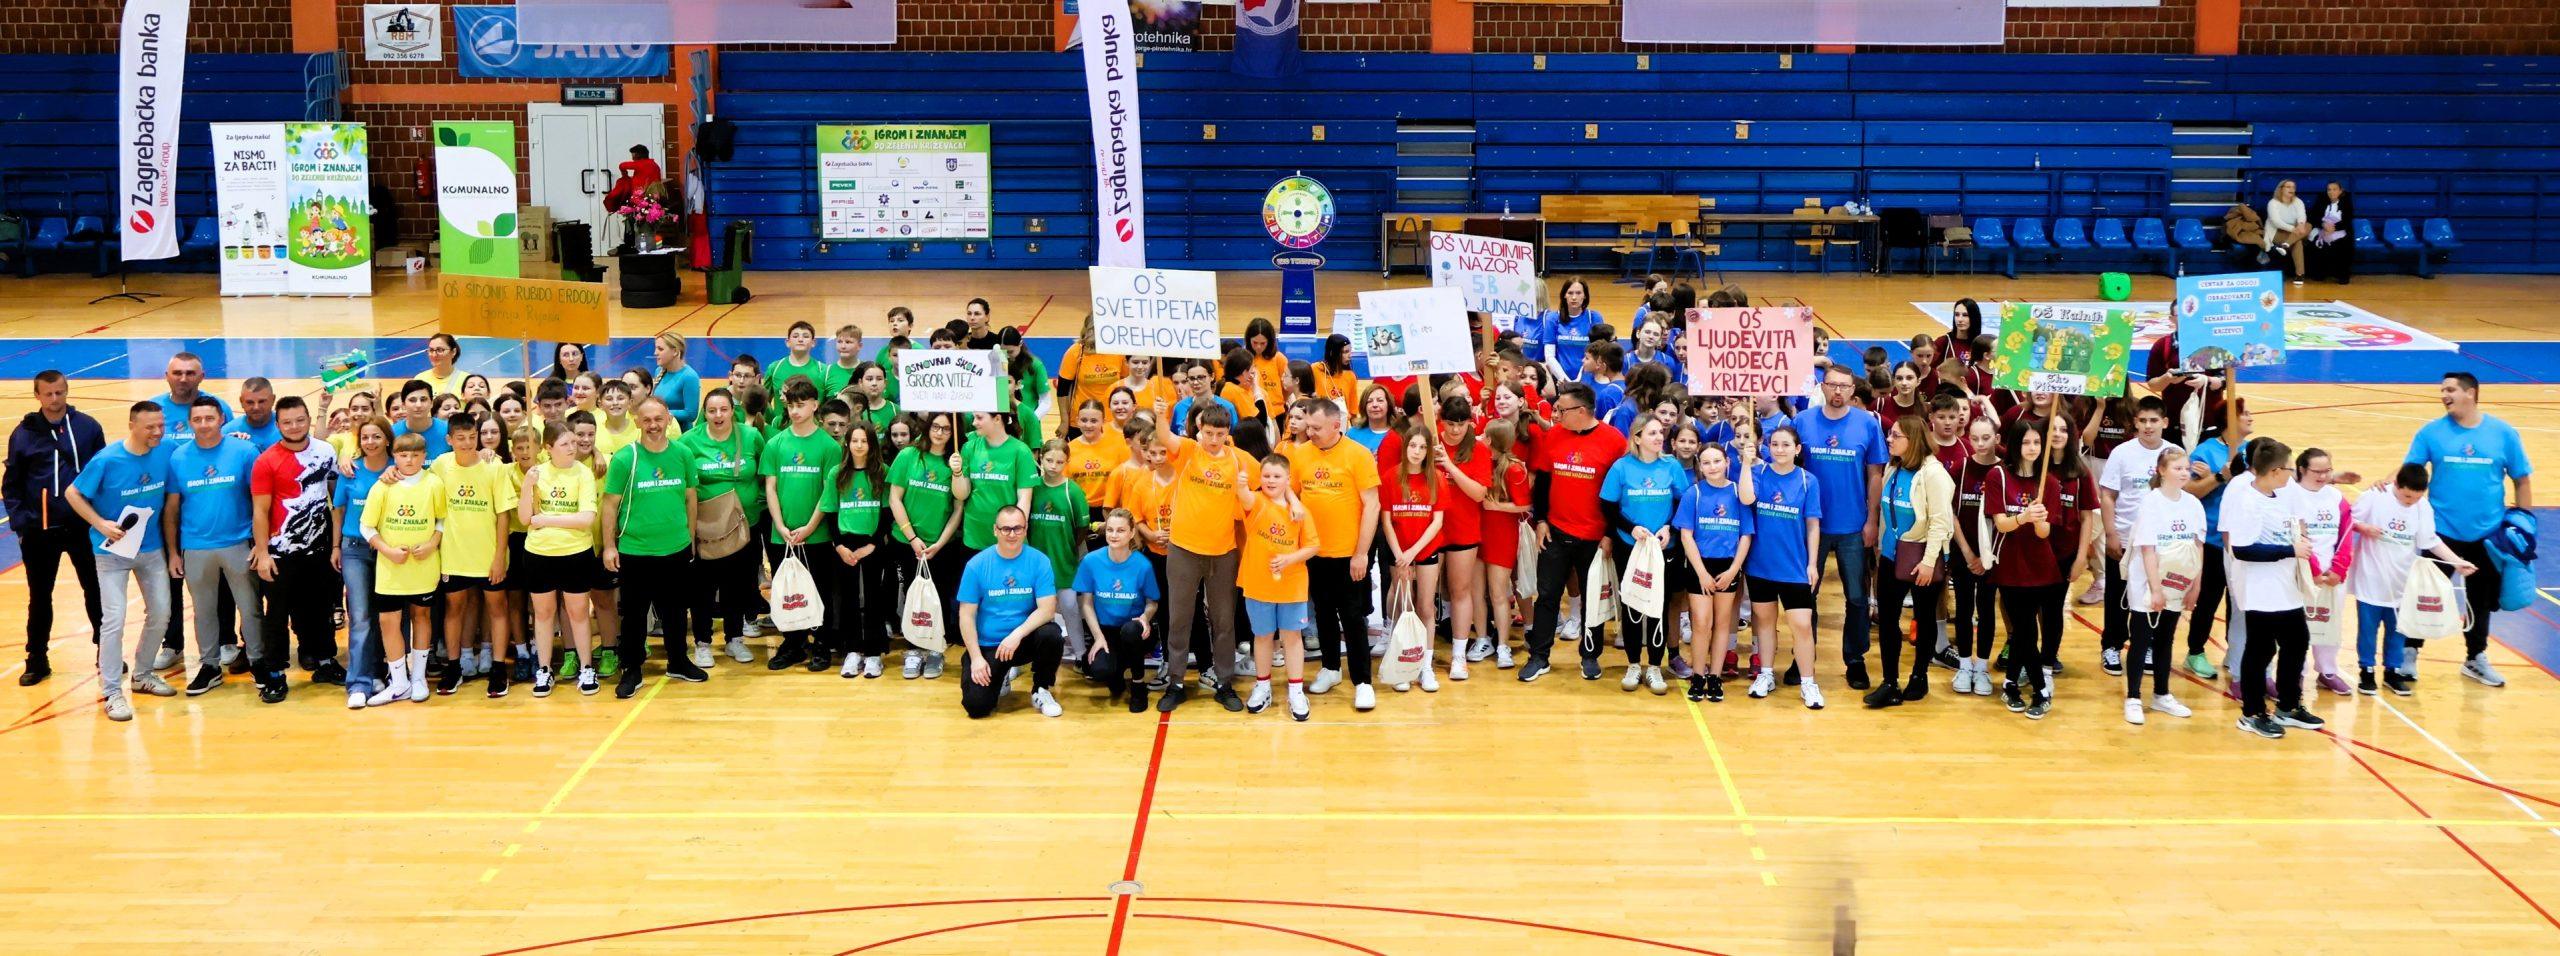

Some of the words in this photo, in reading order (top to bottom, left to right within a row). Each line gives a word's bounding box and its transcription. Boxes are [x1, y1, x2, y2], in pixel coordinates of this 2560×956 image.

[137, 13, 161, 78] banka
[875, 130, 907, 140] IGROM
[916, 129, 967, 140] ZNANJEM
[131, 86, 160, 207] Zagrebačka
[233, 150, 266, 161] NISMO
[224, 162, 240, 171] ZA
[242, 161, 277, 171] BACIT!
[292, 163, 316, 172] IGROM
[323, 163, 362, 172] ZNANJEM
[442, 186, 510, 194] KOMUNALNO
[1430, 233, 1455, 252] OŠ
[1458, 237, 1533, 262] VLADIMIR
[1459, 255, 1520, 275] NAZOR
[1134, 271, 1167, 295] OŠ
[1472, 274, 1499, 295] 5B
[516, 285, 553, 302] RUBIDO
[1477, 297, 1535, 318] JUNACI
[1739, 306, 1762, 329] OŠ
[2033, 306, 2053, 319] OŠ
[1100, 325, 1215, 349] OREHOVEC
[1698, 328, 1796, 350] LJUDEVITA
[905, 356, 951, 375] OSNOVNA
[1709, 351, 1789, 371] MODECA
[907, 373, 944, 388] GRIGOR
[946, 373, 974, 388] VITEZ
